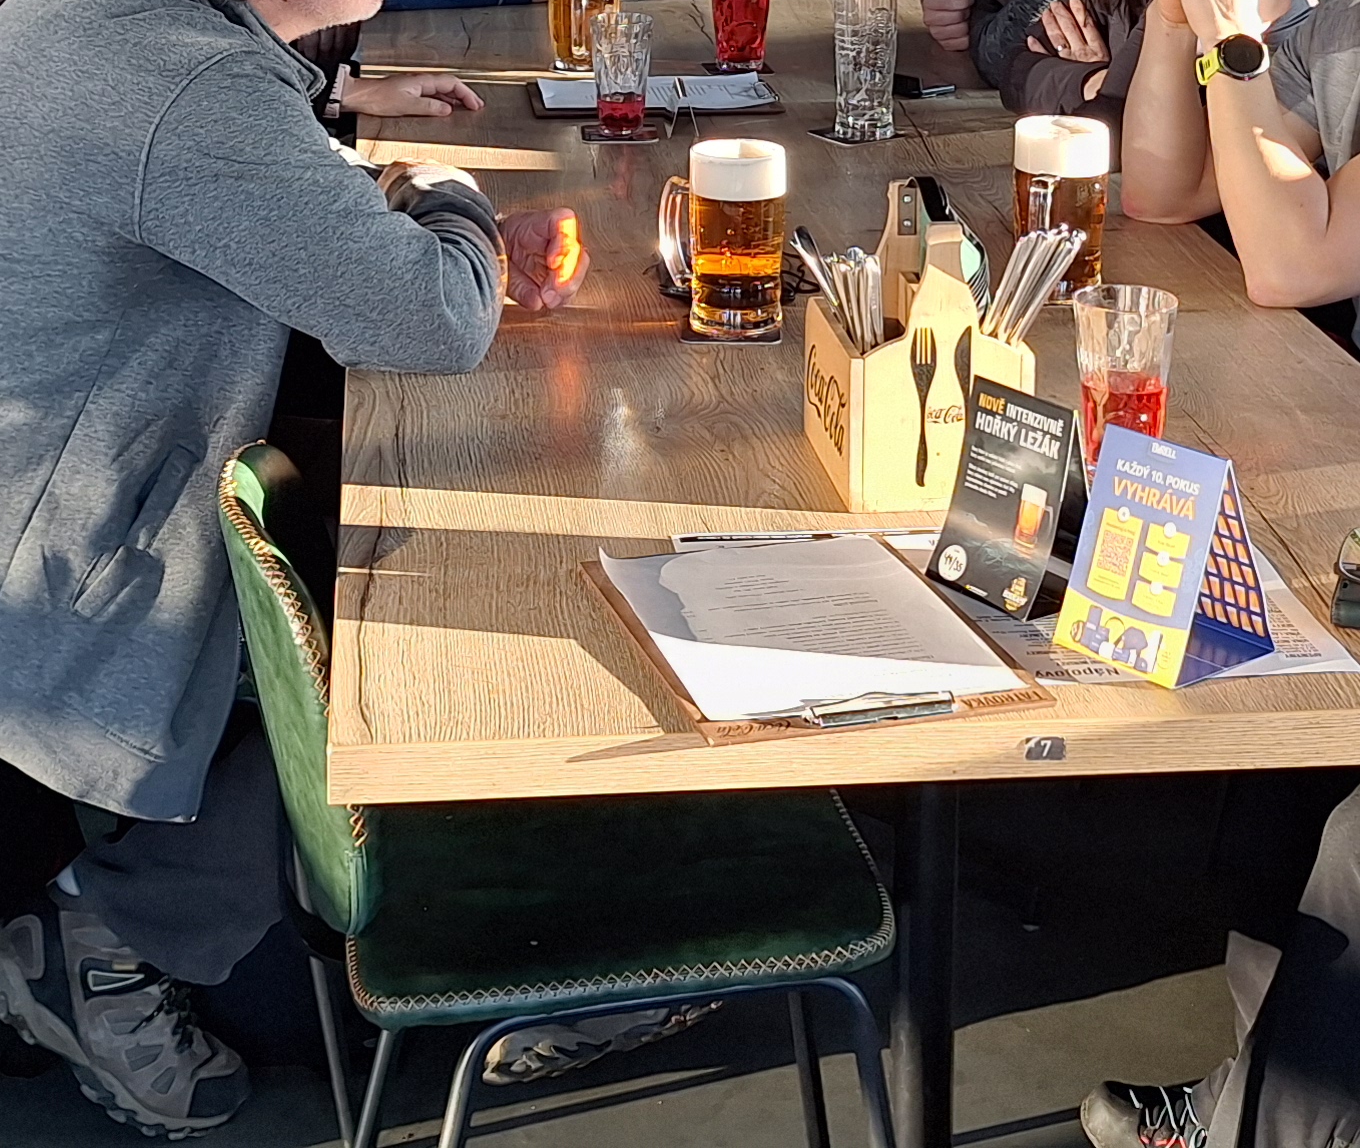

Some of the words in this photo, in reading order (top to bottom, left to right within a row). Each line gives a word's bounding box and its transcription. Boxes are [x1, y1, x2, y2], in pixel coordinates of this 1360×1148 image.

[975, 411, 1018, 442] HOŘKÝ
[1018, 428, 1061, 460] LEŽÁK
[978, 392, 1006, 414] NOVĚ
[1005, 404, 1064, 438] INTENZIVNĚ
[1113, 476, 1197, 520] VYHRÁVÁ
[1116, 457, 1151, 479] KAŽDÝ
[1150, 468, 1165, 485] 10.
[1165, 474, 1201, 496] POKUS
[960, 690, 1048, 710] TATROVKA
